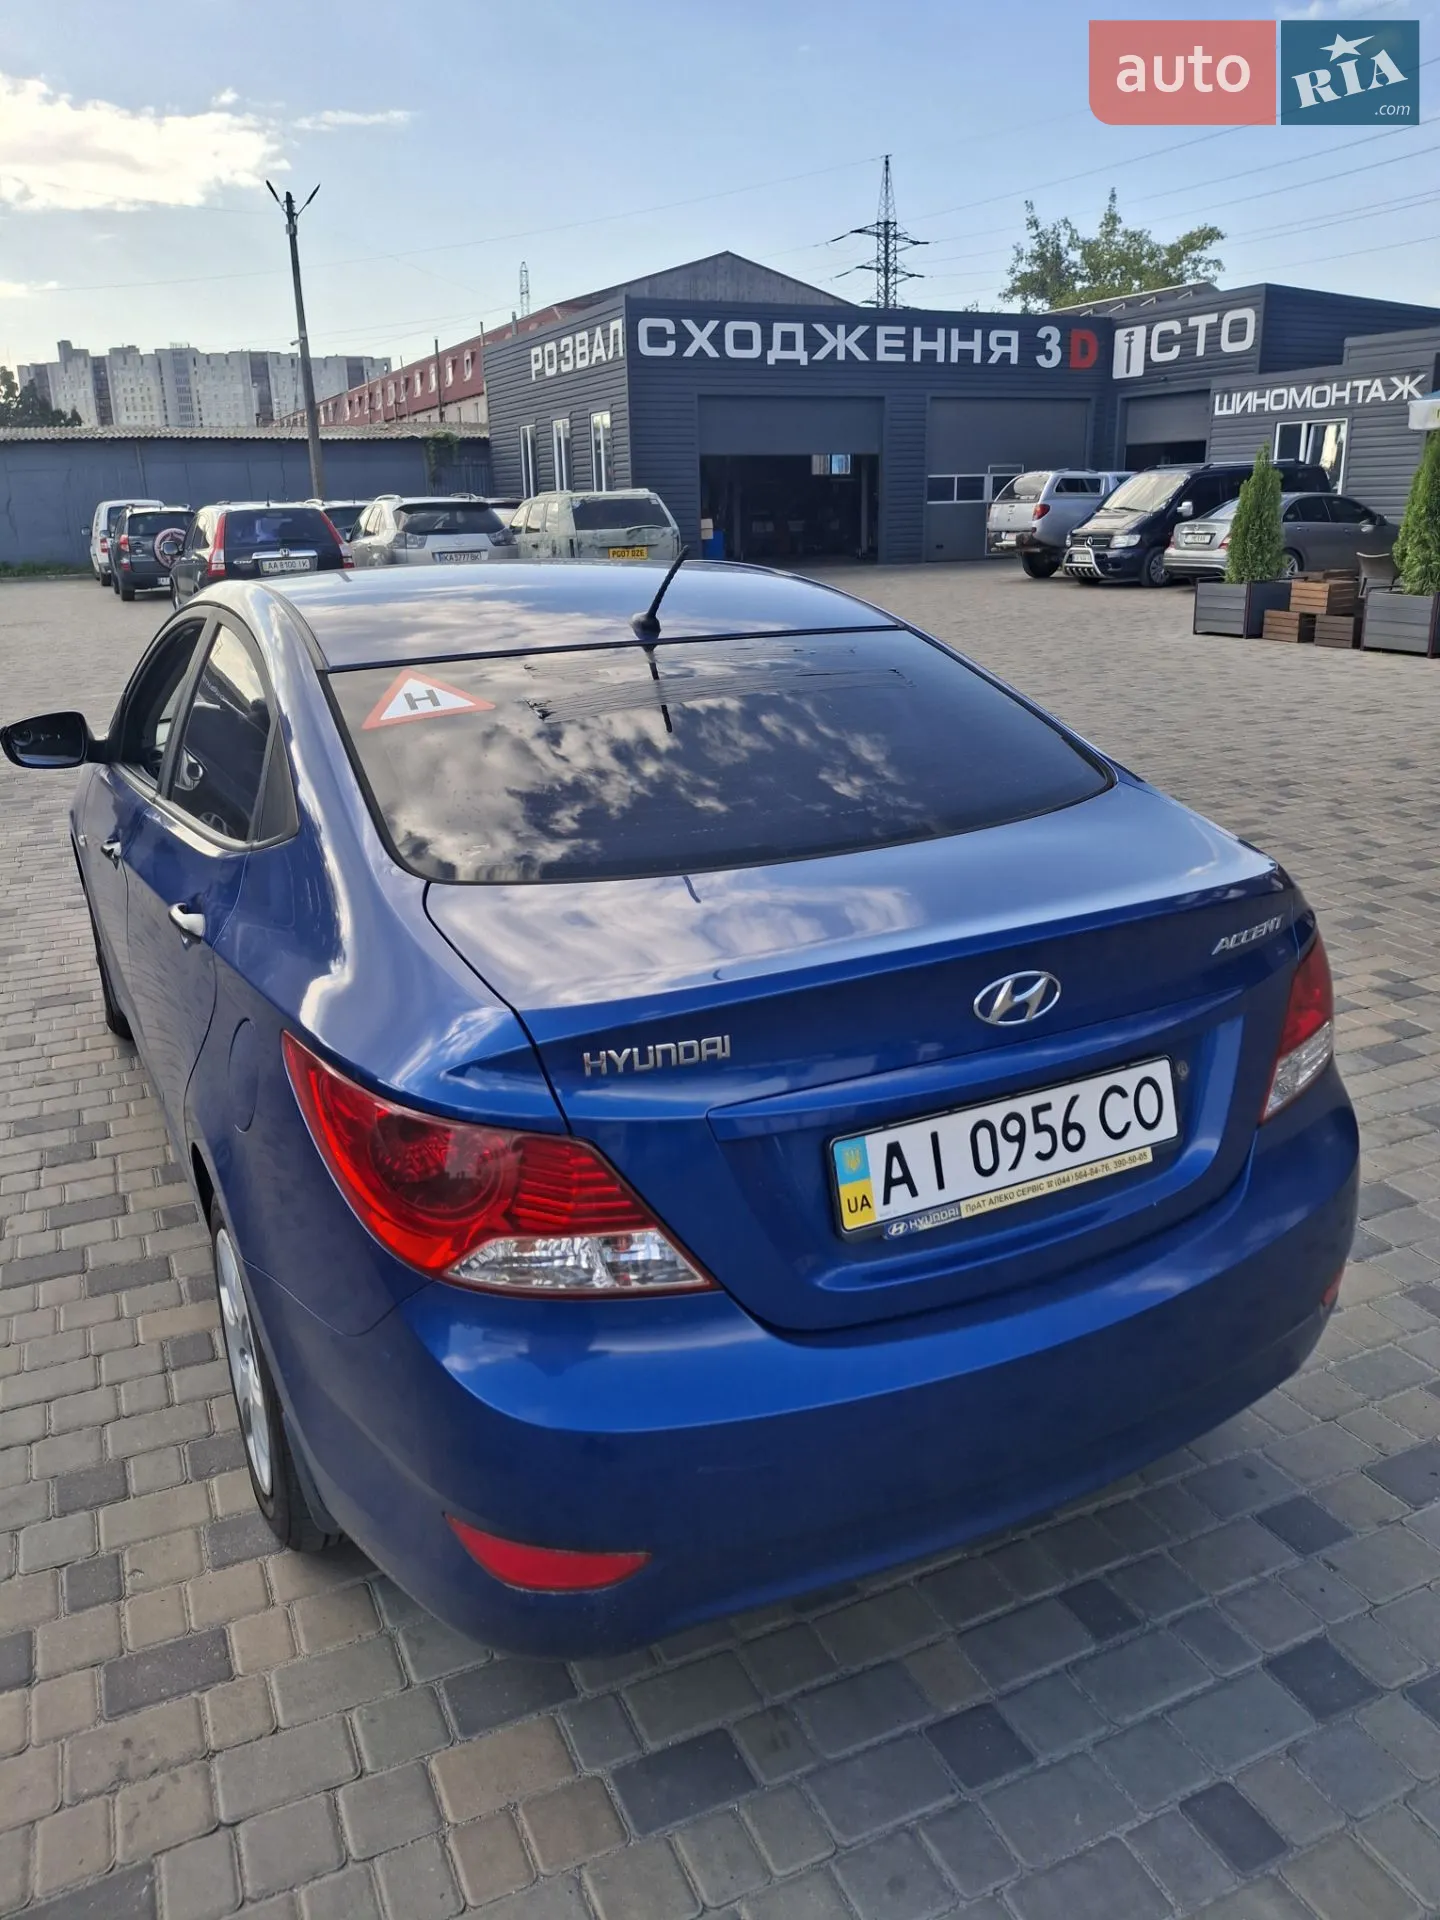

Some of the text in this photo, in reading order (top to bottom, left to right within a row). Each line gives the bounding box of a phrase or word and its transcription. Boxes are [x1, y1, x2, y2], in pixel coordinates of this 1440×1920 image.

[531, 319, 624, 380] РОЗВАЛ
[637, 317, 1098, 369] СХОДЖЕННЯ 3D
[1150, 308, 1255, 362] СТО
[1213, 373, 1425, 416] ШИНОМОНТАЖ
[1211, 914, 1285, 956] ACCENT
[583, 1035, 731, 1077] HYUNDAI
[882, 1076, 1164, 1206] AI 0956 CO
[847, 1193, 872, 1214] UA
[988, 1191, 1015, 1206] АЛЕКО
[1016, 1182, 1045, 1197] СЕРВІС
[909, 1208, 959, 1230] HYUNDAI
